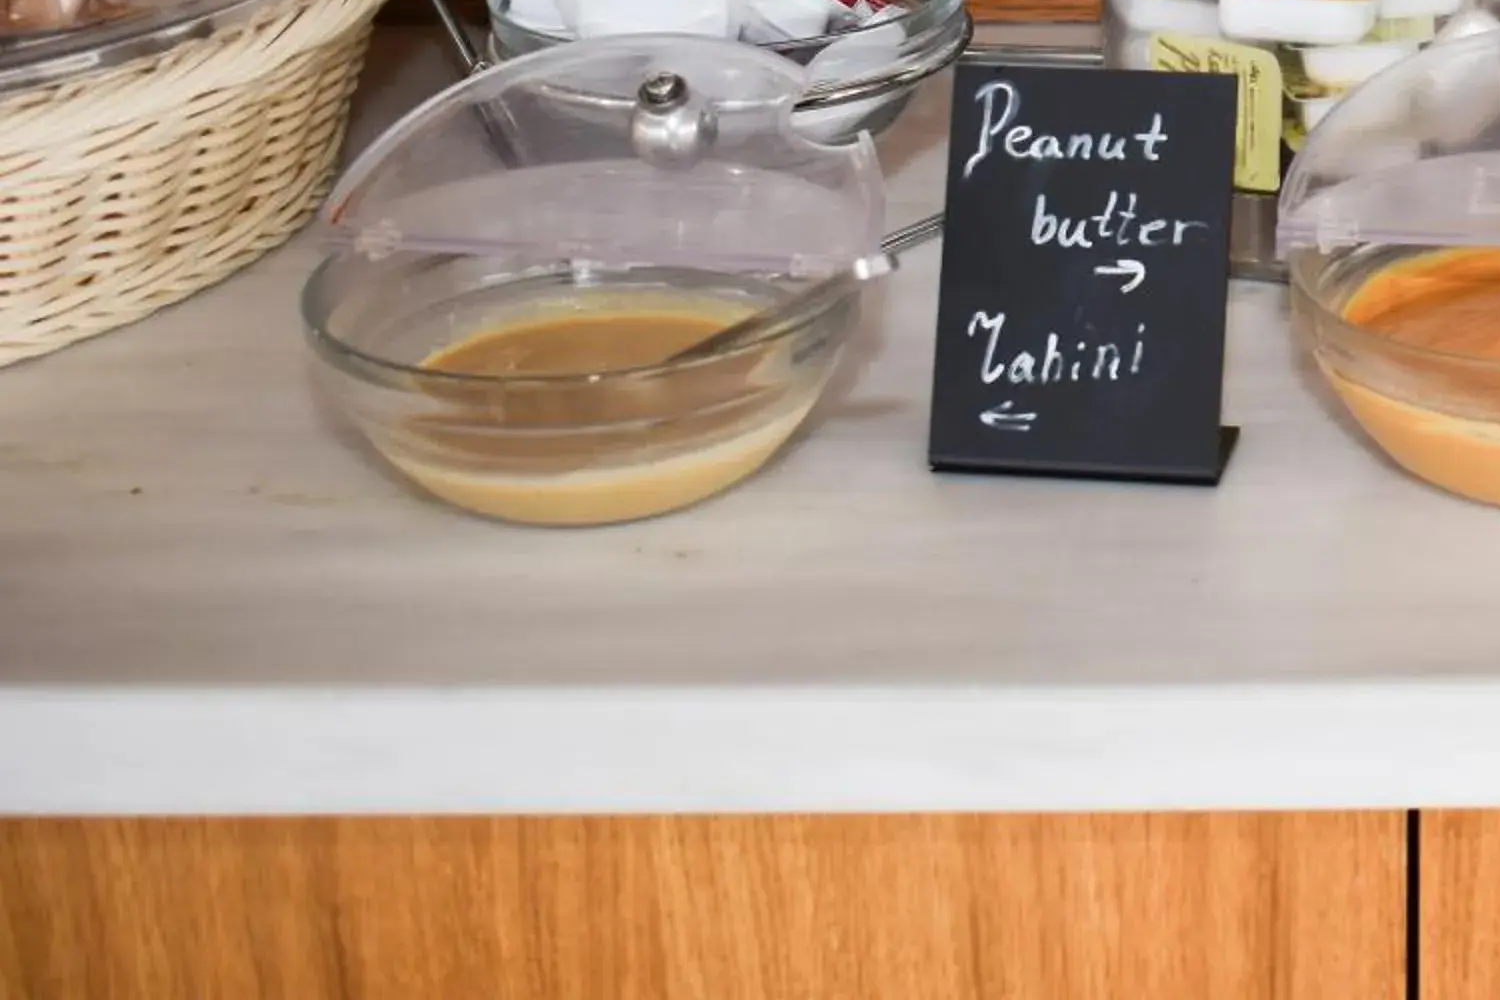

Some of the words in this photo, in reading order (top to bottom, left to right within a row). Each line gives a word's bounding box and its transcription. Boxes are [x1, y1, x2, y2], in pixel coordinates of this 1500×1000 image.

[962, 82, 1169, 179] Peanut
[1031, 190, 1210, 249] butter
[966, 309, 1147, 385] Tahini
